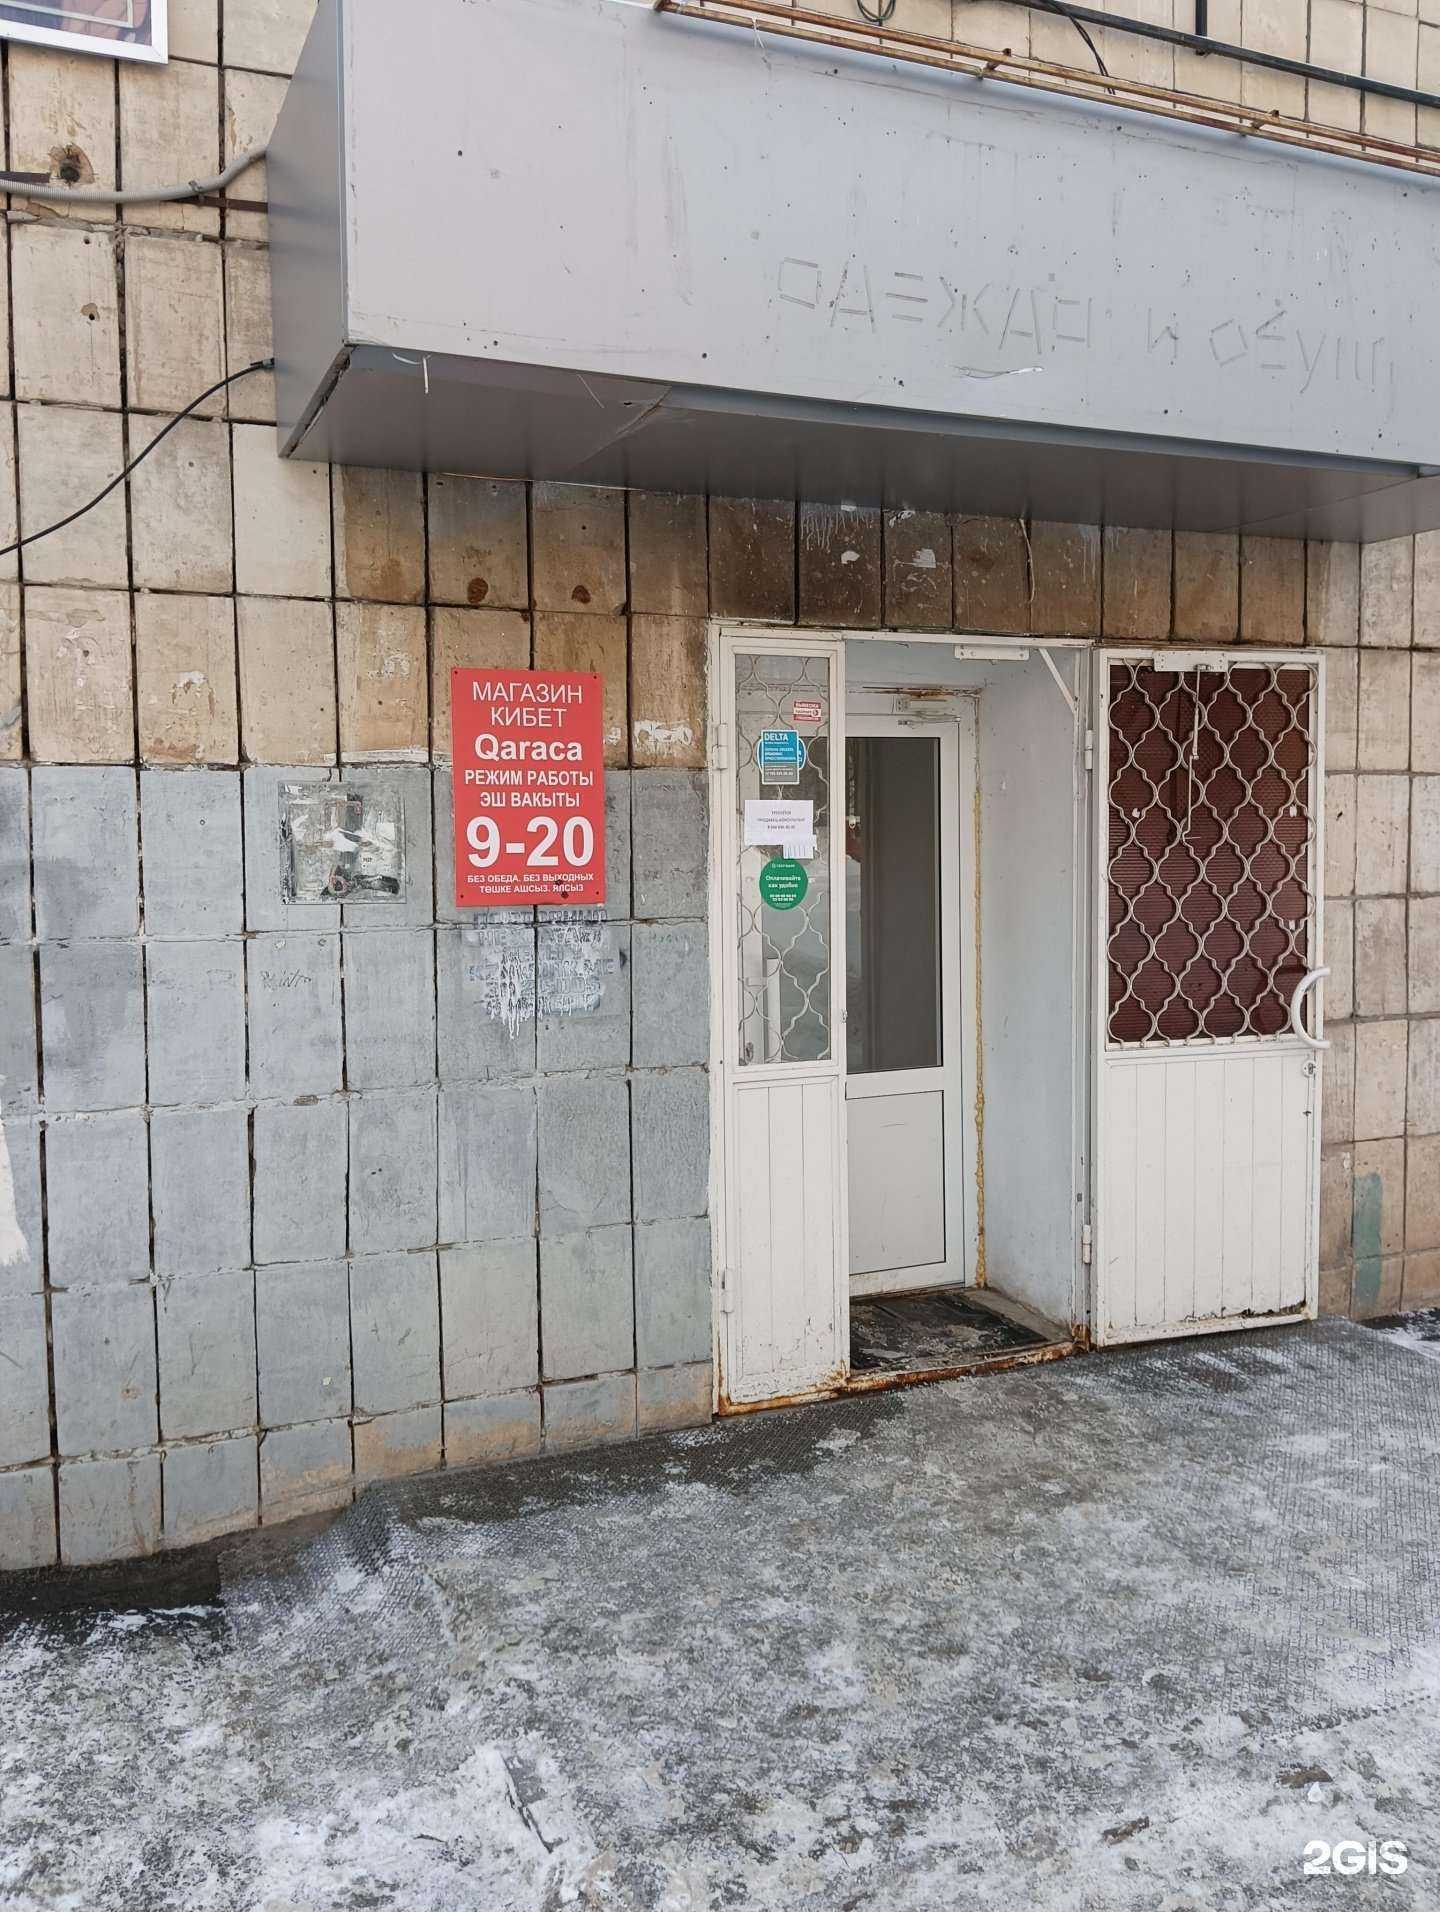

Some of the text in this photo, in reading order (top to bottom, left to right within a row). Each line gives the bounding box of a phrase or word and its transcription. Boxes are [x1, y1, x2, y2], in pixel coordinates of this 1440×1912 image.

[472, 681, 583, 704] МАГАЗИН
[490, 706, 567, 728] КИБЕТ
[764, 732, 789, 742] DELTA
[474, 733, 583, 762] Qaraca
[464, 769, 594, 786] РЕЖИМ РАБОТЫ
[480, 791, 580, 808] ЭШ ВАКЫТЫ
[466, 815, 594, 868] 9-20
[467, 873, 594, 884] БЕЗ ОБЕДА. БЕЗ ВЫХОДНЫХ
[480, 885, 512, 894] ТӨШКЕ
[552, 884, 584, 892] ЯЛСЫЗ
